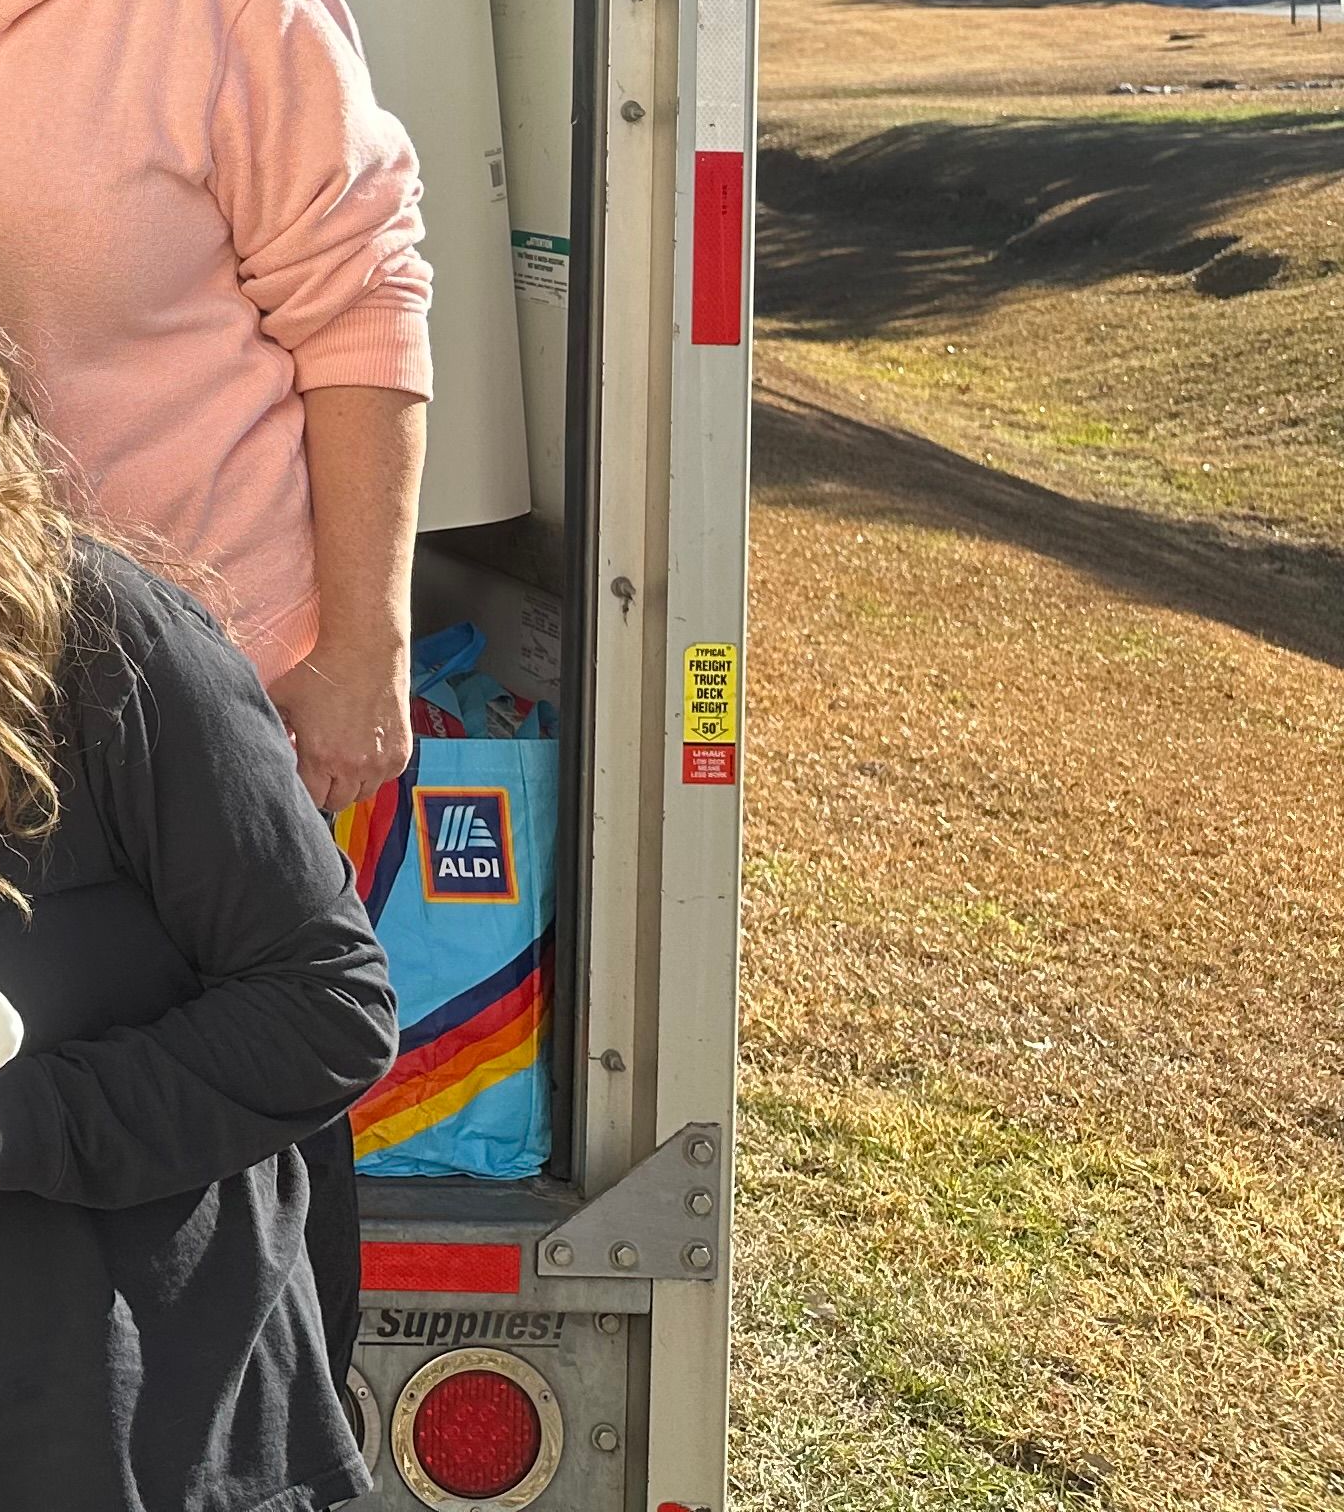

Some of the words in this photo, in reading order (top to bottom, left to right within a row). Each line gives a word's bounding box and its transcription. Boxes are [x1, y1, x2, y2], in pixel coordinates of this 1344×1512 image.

[695, 648, 727, 657] TYPICAL
[689, 660, 732, 672] FREIGHT
[693, 673, 728, 686] TRUCK
[696, 687, 724, 700] DECK
[691, 701, 729, 714] HEIGHT
[438, 855, 500, 881] ALDI
[376, 1309, 567, 1346] Supplies!
